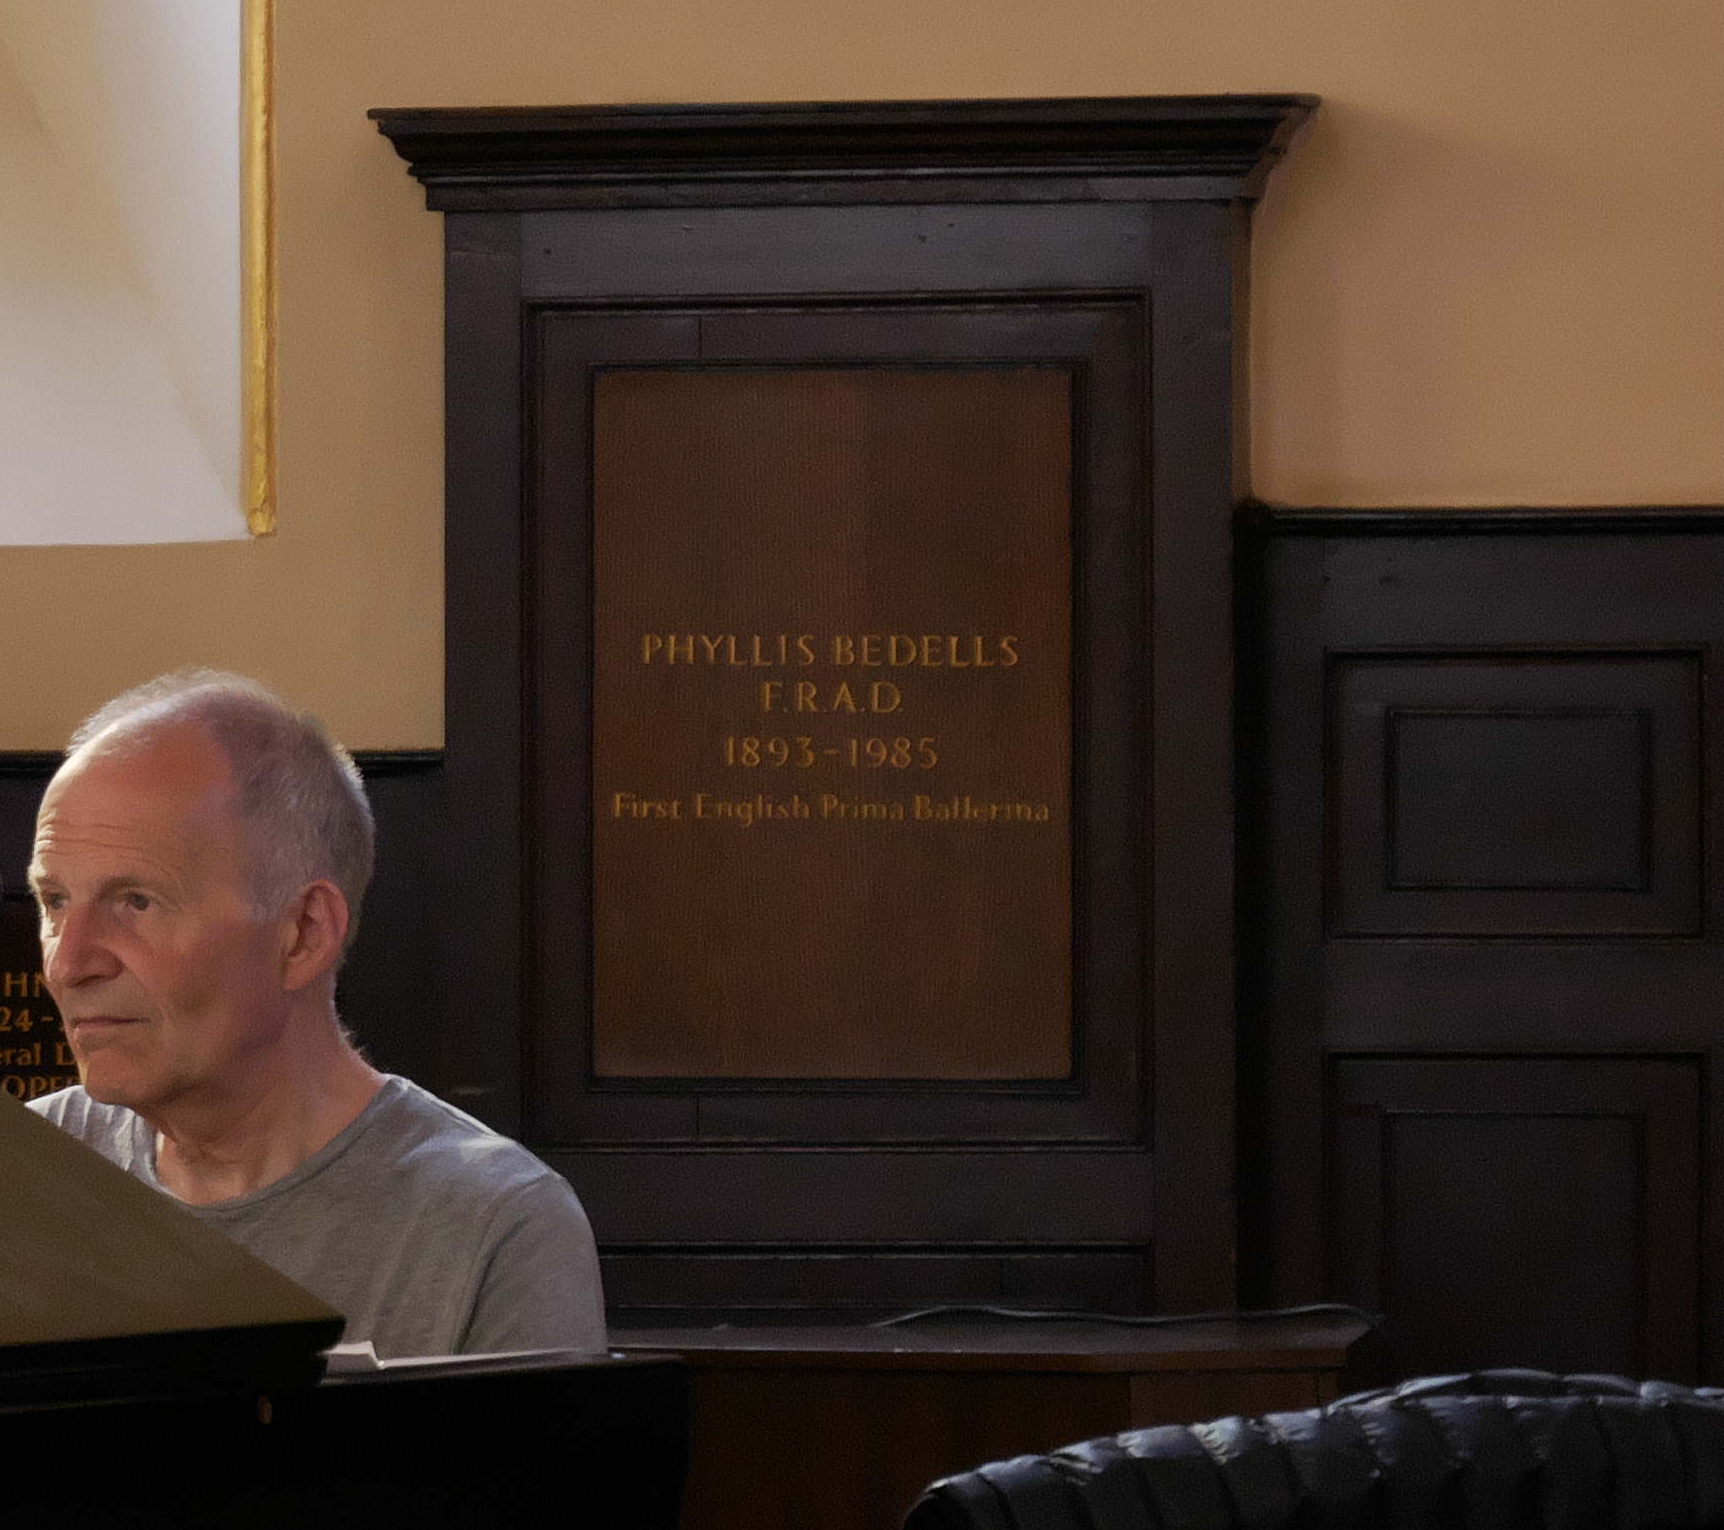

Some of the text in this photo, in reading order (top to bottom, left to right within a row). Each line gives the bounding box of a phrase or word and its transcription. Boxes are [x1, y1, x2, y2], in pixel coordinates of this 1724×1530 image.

[640, 633, 1019, 667] PHYLLIS BEDELLS
[612, 792, 1050, 827] First English Prima Ballerina
